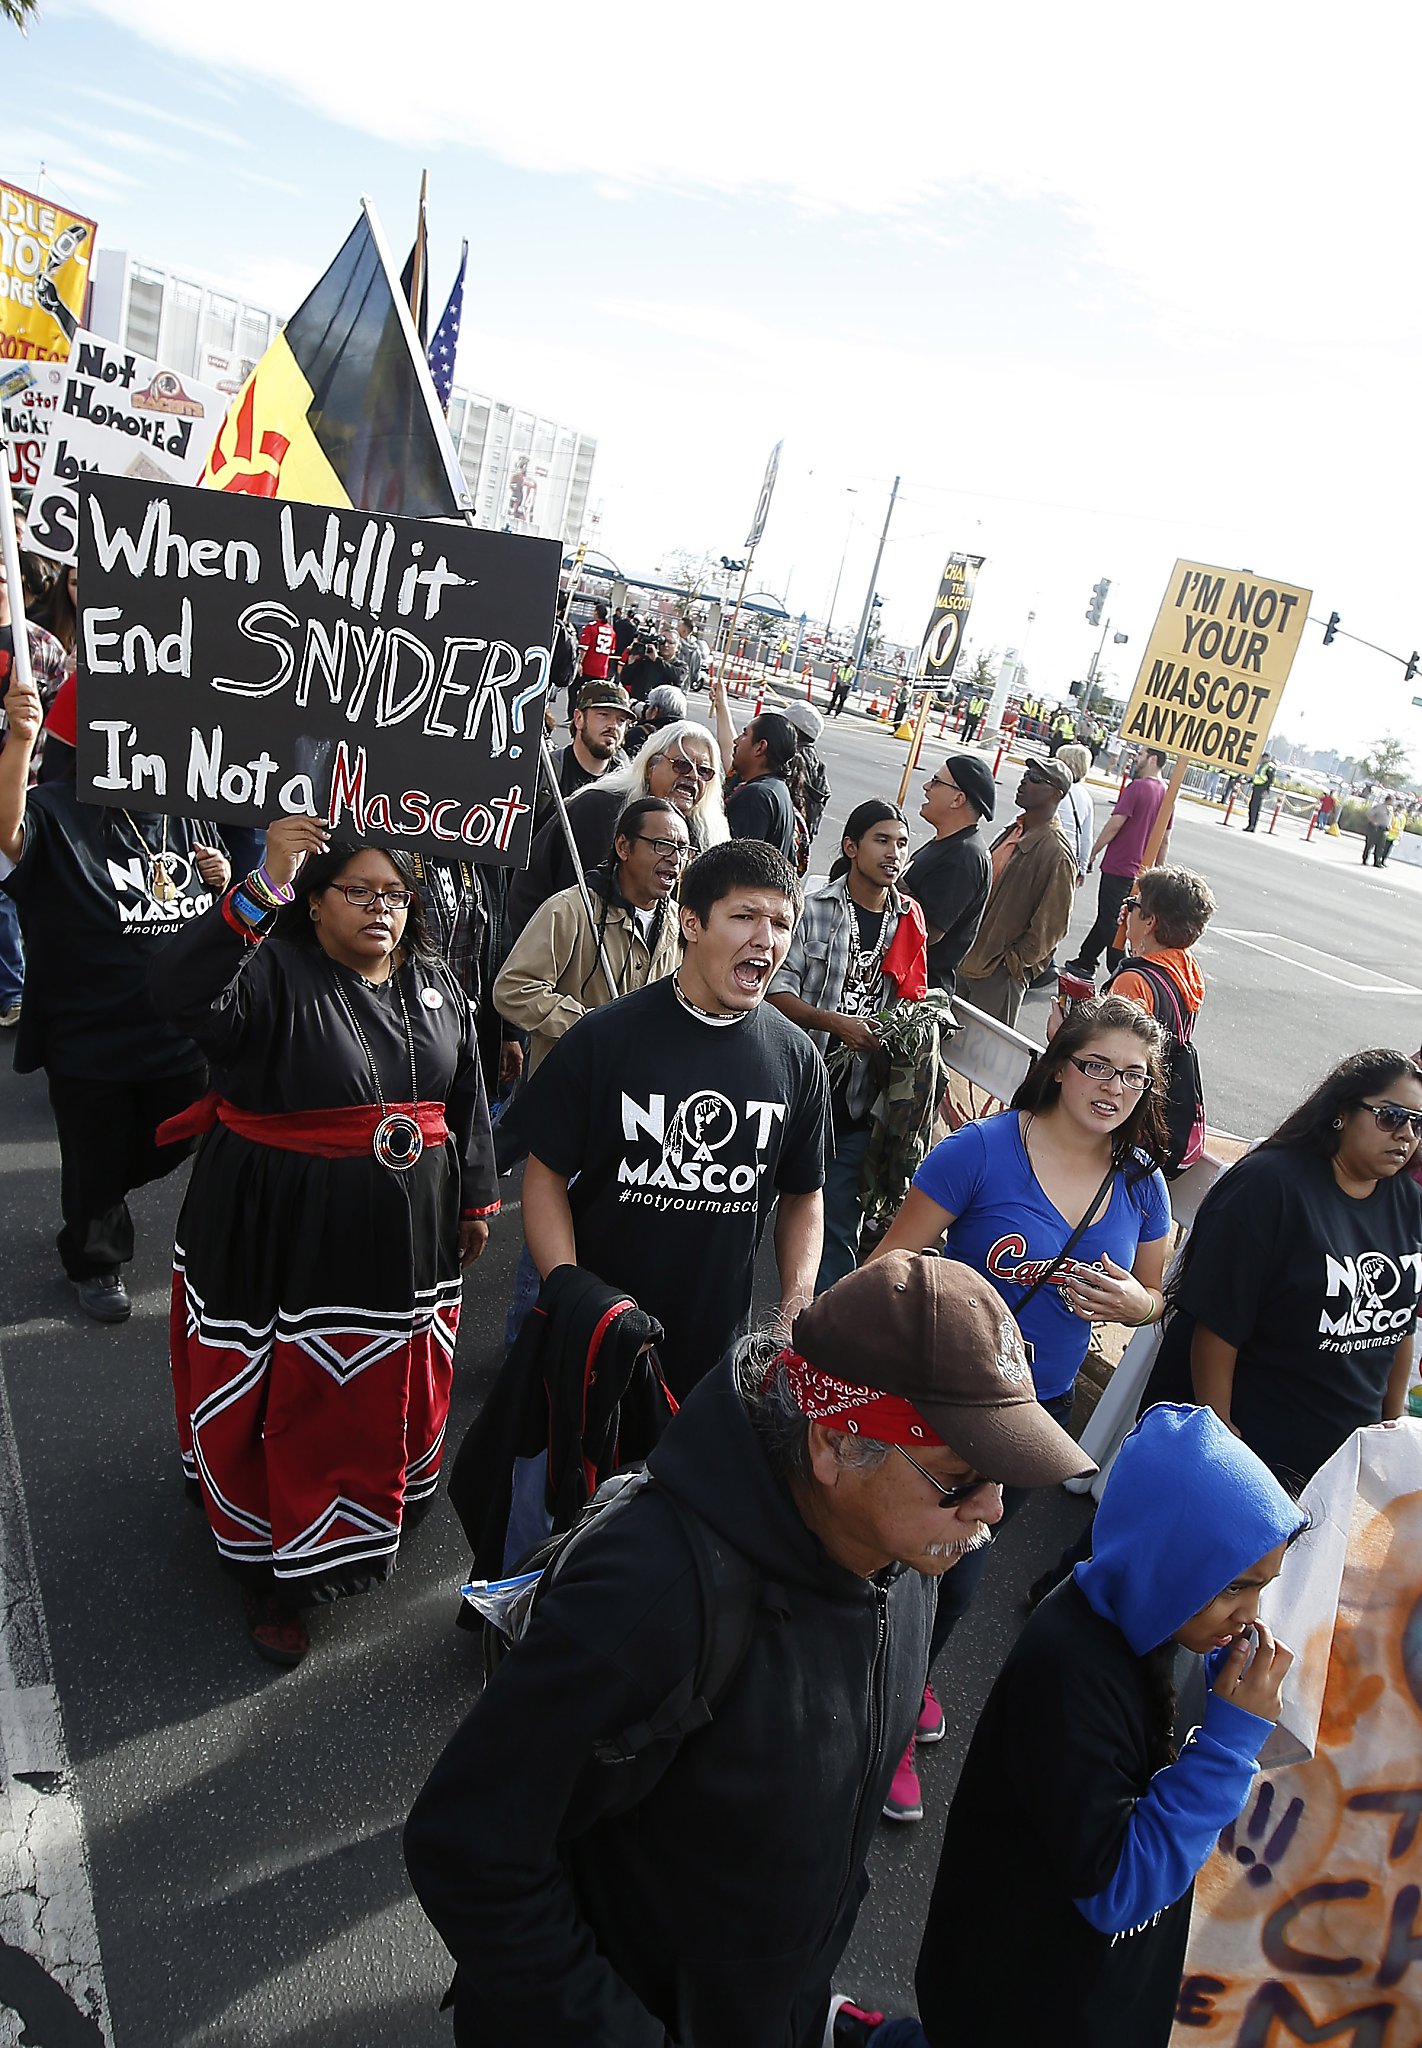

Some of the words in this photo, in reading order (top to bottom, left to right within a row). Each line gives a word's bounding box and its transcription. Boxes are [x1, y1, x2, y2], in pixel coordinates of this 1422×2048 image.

[76, 343, 136, 388] Not
[88, 494, 260, 584] When
[280, 505, 396, 618] Will
[1175, 570, 1226, 615] I'M
[1227, 582, 1298, 633] NOT
[1181, 614, 1269, 673] YOUR
[83, 597, 192, 678] End
[209, 600, 551, 759] SNYDER?
[1144, 659, 1271, 725] MASCOT
[1127, 702, 1258, 767] ANYMORE
[89, 720, 166, 795] I'm
[186, 725, 279, 808] Not
[279, 772, 318, 817] a
[329, 740, 531, 852] Mascot
[414, 852, 424, 879] Nikon
[461, 862, 472, 887] Nikon
[621, 1089, 786, 1151] NOT
[617, 1156, 767, 1194] MASCO
[692, 1140, 714, 1162] A
[1318, 1304, 1416, 1336] MASCO
[1365, 1292, 1384, 1309] A
